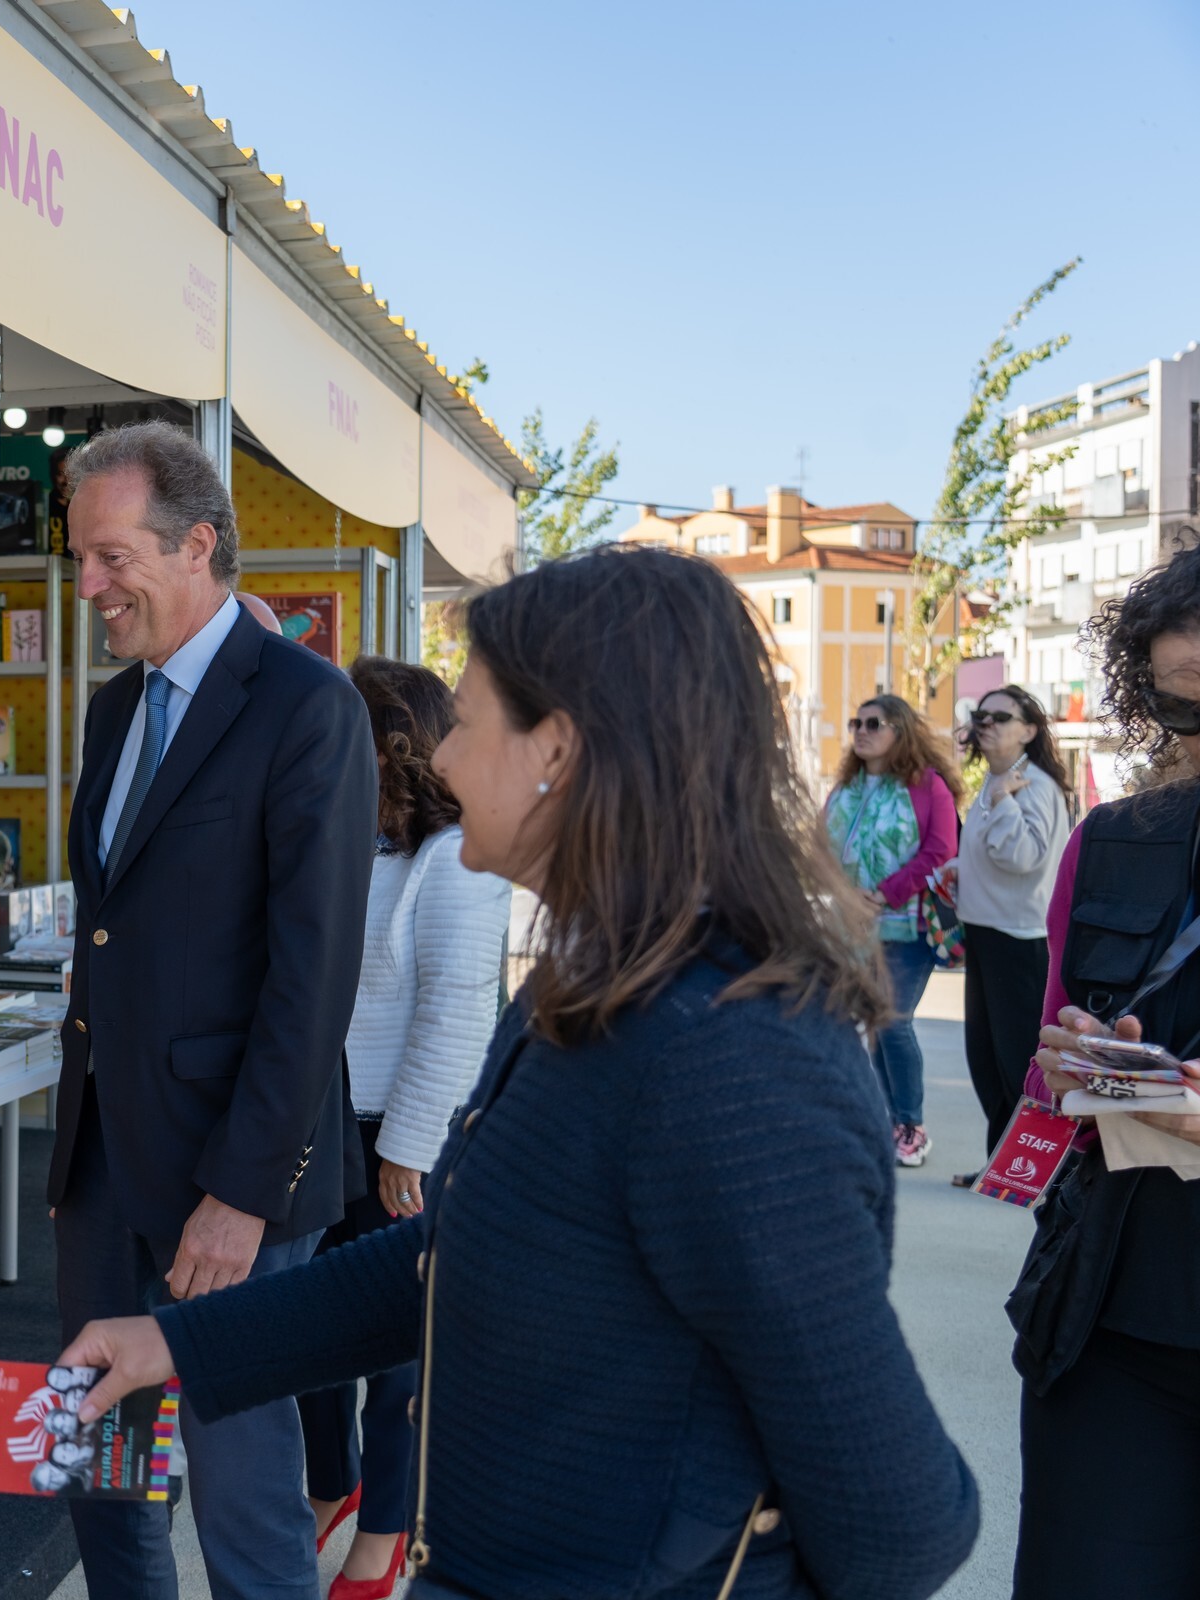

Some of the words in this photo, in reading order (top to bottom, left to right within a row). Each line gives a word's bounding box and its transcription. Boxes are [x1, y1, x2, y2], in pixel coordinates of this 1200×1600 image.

[188, 262, 216, 302] ROMANCE
[328, 379, 359, 444] FNAC
[1017, 1132, 1058, 1153] STAFF
[987, 1172, 1001, 1181] FEIRA
[1008, 1178, 1023, 1189] LIVRO
[1022, 1182, 1041, 1194] AVEIRO
[103, 1422, 114, 1443] DO
[101, 1446, 113, 1488] FEIRA
[111, 1434, 124, 1489] AVEIRO
